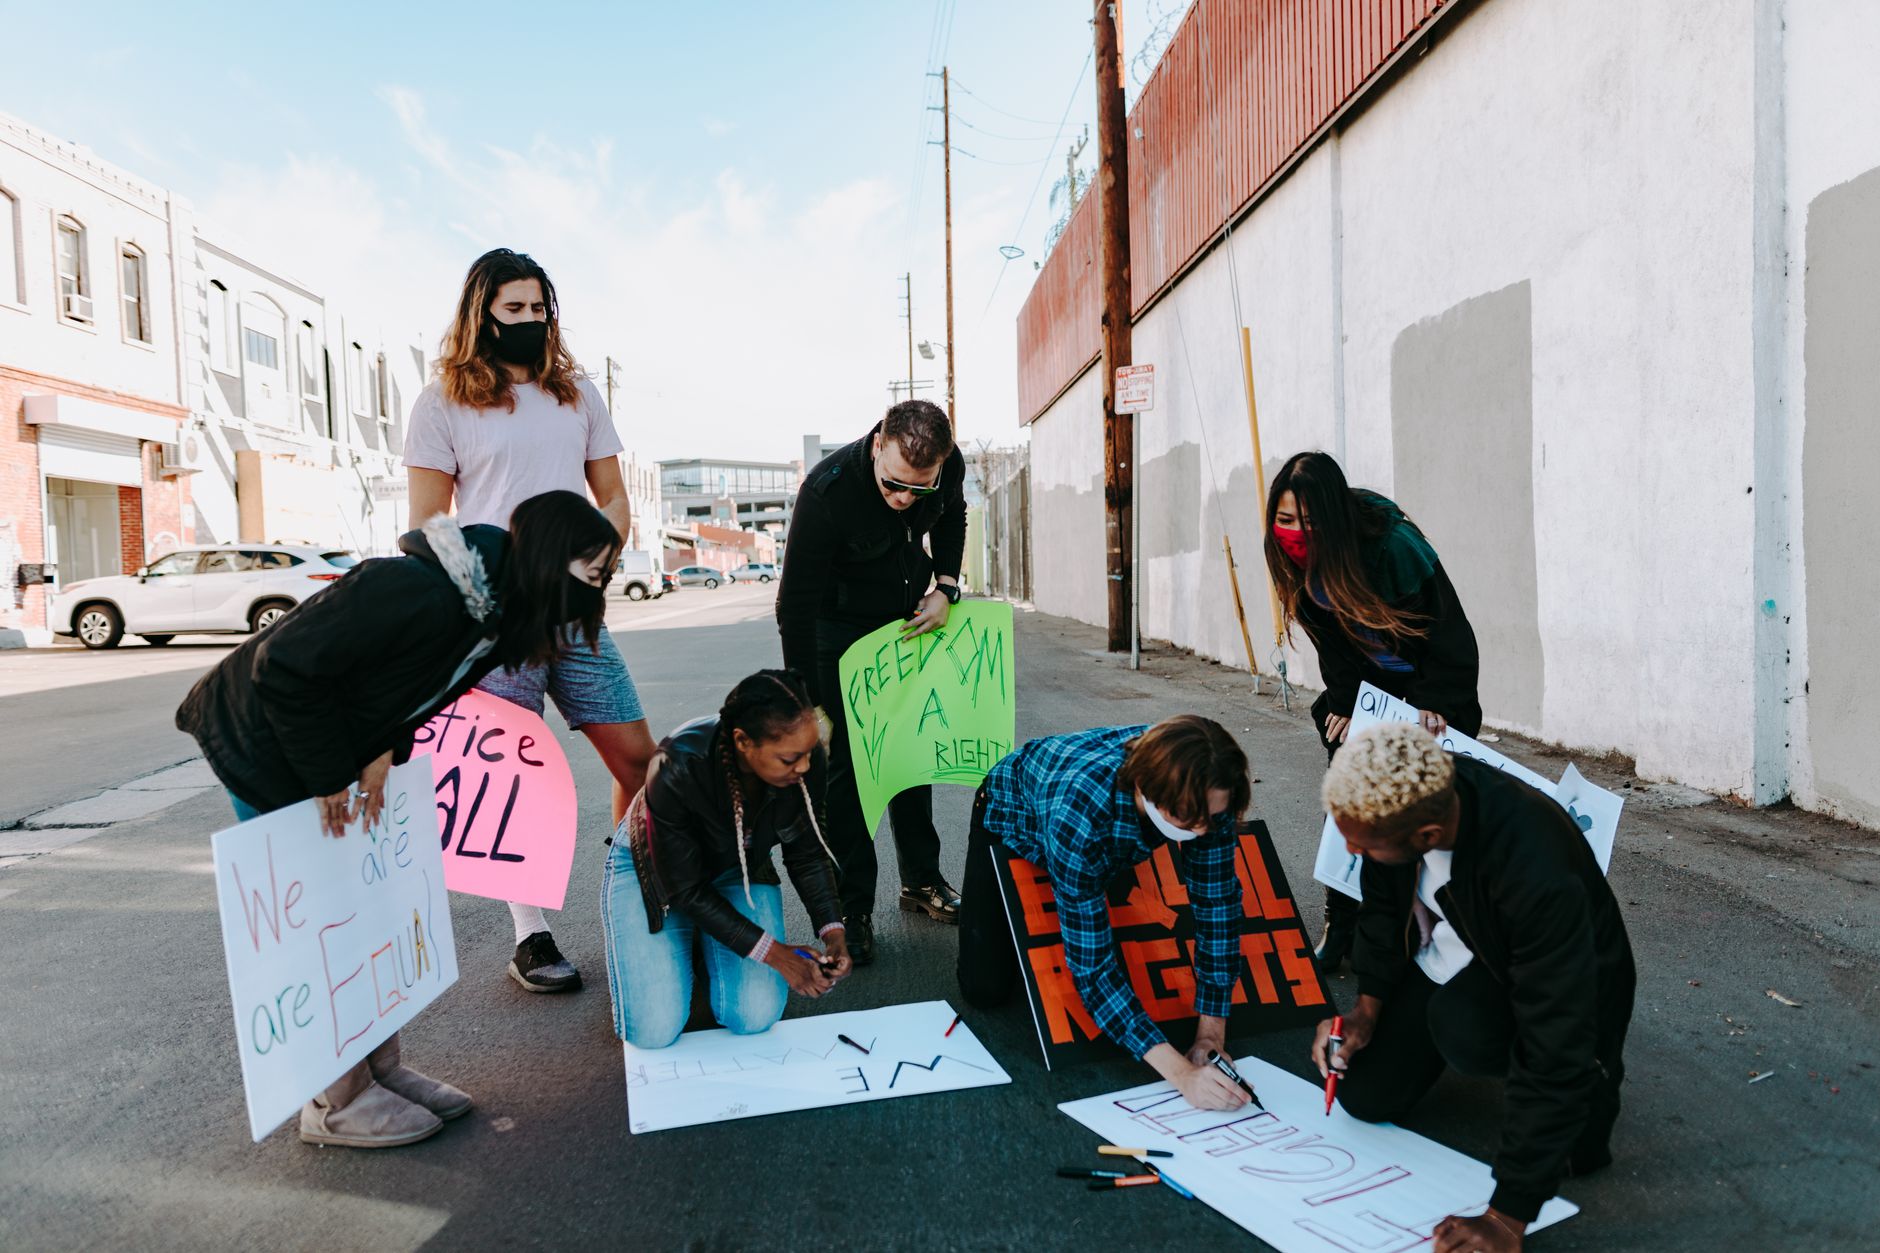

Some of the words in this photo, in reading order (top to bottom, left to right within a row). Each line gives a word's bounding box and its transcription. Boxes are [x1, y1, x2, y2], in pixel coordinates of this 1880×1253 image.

[1121, 390, 1132, 398] ANY
[1134, 388, 1150, 397] TIME
[848, 616, 1006, 729] FREEDOM
[414, 702, 544, 767] stice
[916, 687, 949, 737] A
[1361, 691, 1389, 720] all
[361, 831, 413, 886] are
[231, 833, 308, 954] We
[1027, 928, 1328, 1045] RGTS
[250, 982, 315, 1056] are
[834, 1053, 995, 1096] WE
